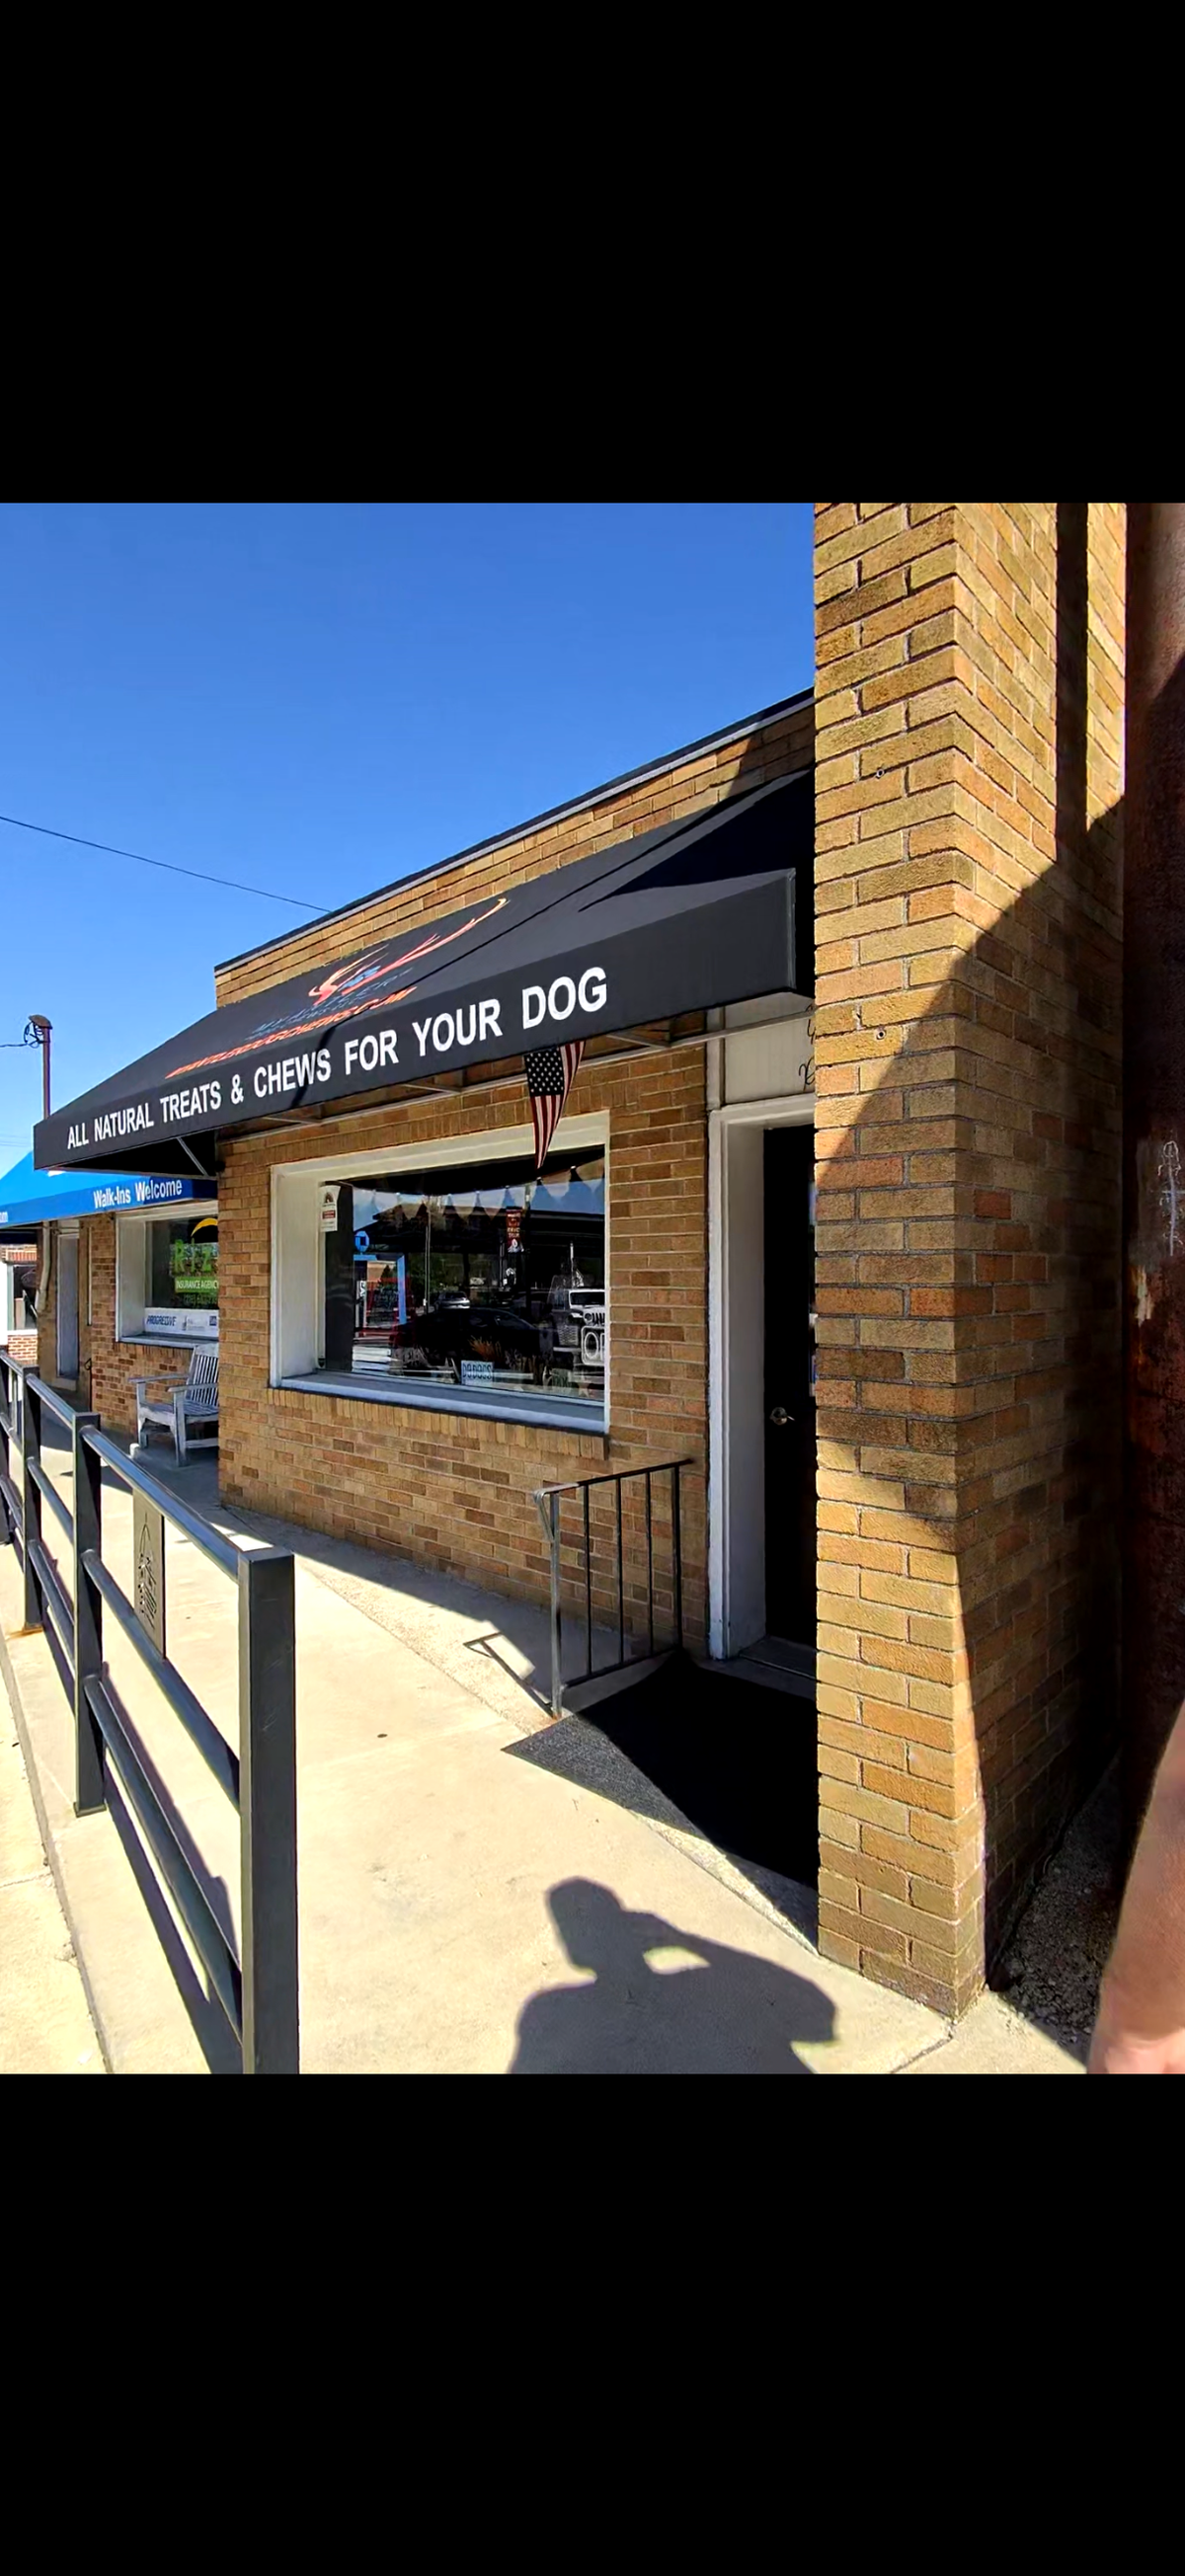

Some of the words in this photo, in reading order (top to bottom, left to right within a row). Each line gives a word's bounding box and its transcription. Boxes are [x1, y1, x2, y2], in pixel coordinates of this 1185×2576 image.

[67, 1123, 89, 1149] ALL
[94, 1103, 154, 1141] NATURAL
[160, 1081, 221, 1123] TREATS
[230, 1074, 244, 1104] &
[254, 1049, 331, 1098] CHEWS
[345, 1029, 399, 1075] FOR
[412, 998, 504, 1056] YOUR
[521, 967, 607, 1030] DOG
[93, 1186, 131, 1209] Walk-Ins
[134, 1179, 183, 1202] Welcome
